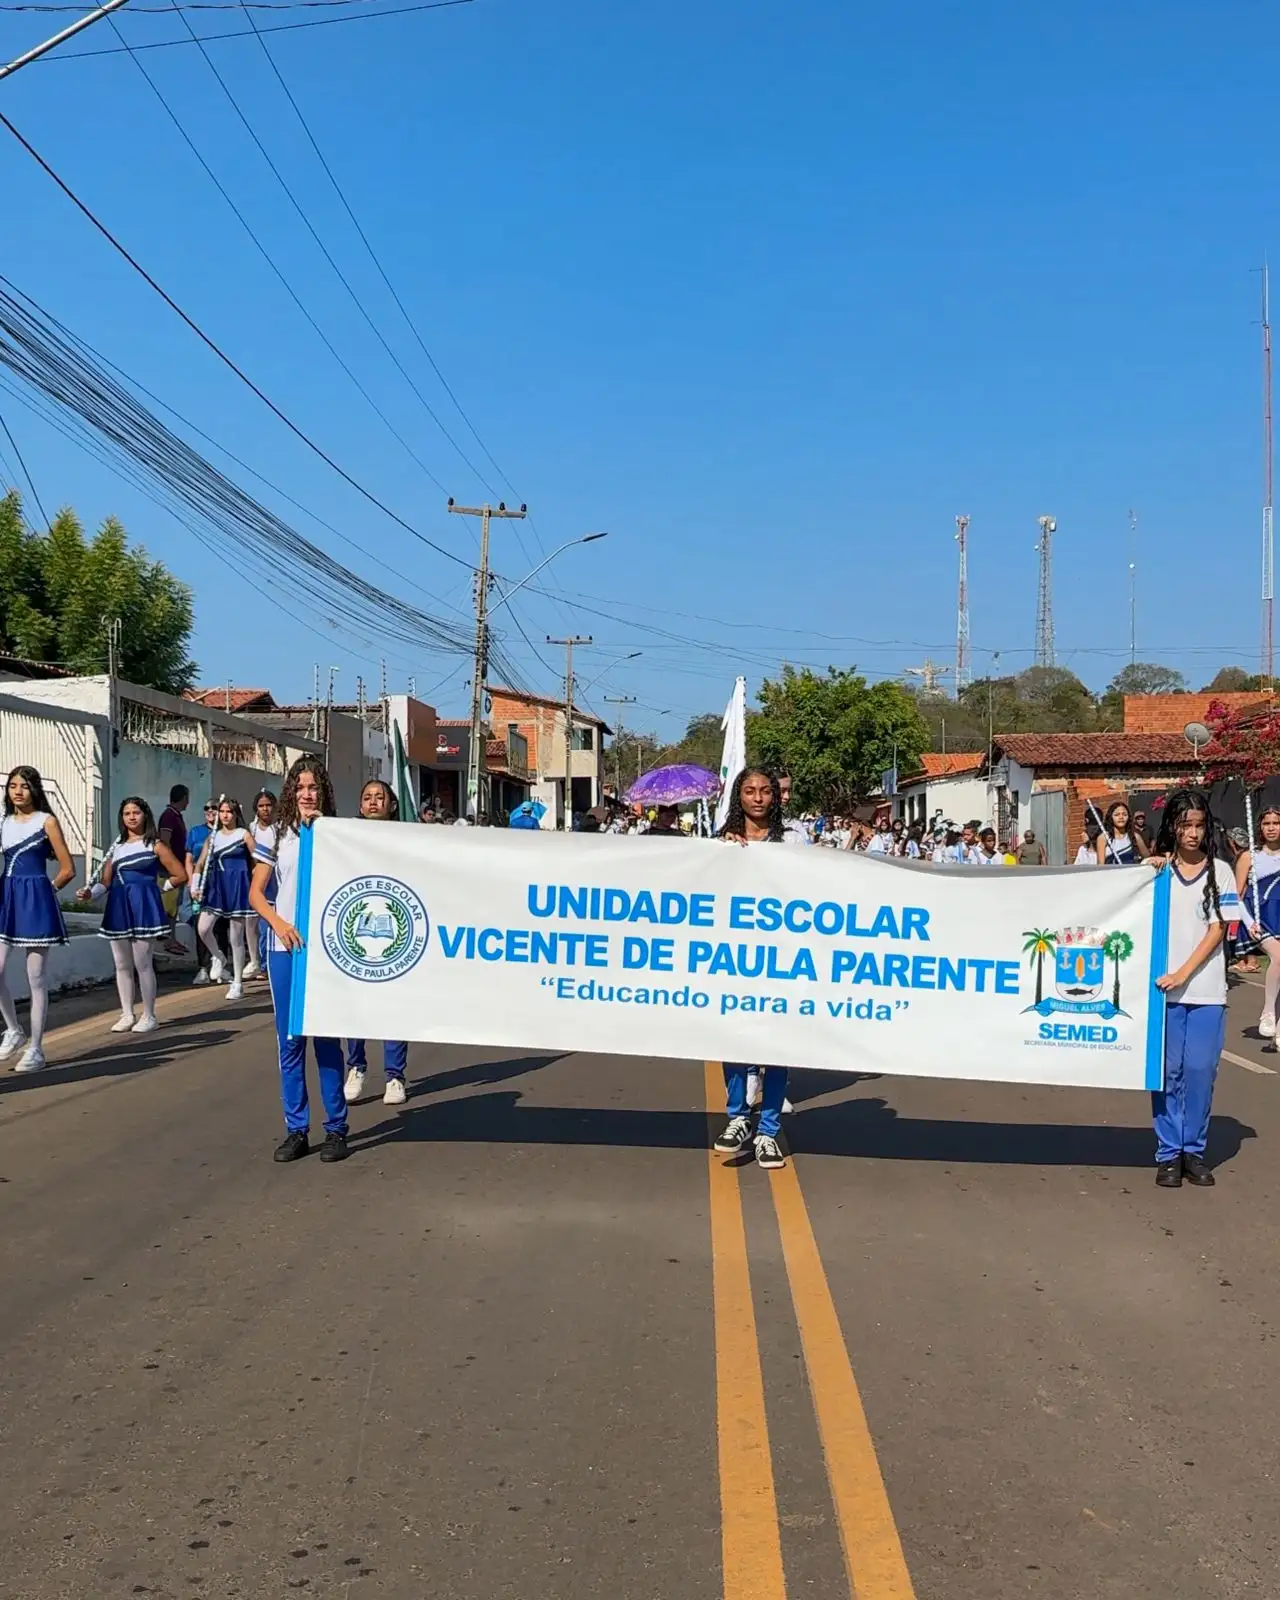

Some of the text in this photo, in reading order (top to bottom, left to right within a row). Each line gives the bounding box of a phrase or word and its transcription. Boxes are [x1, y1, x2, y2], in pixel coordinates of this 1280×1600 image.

[328, 880, 423, 921] UNIDADE ESCOLAR
[528, 884, 931, 941] UNIDADE ESCOLAR
[325, 932, 424, 978] VICENTE DE PAULA PARENTE
[437, 925, 1021, 995] VICENTE DE PAULA PARENTE
[540, 976, 910, 1021] “Educando para a vida”
[1023, 1039, 1057, 1047] SECRETARIA
[1057, 1042, 1089, 1050] MUNICIPAL
[1038, 1022, 1118, 1043] SEMED
